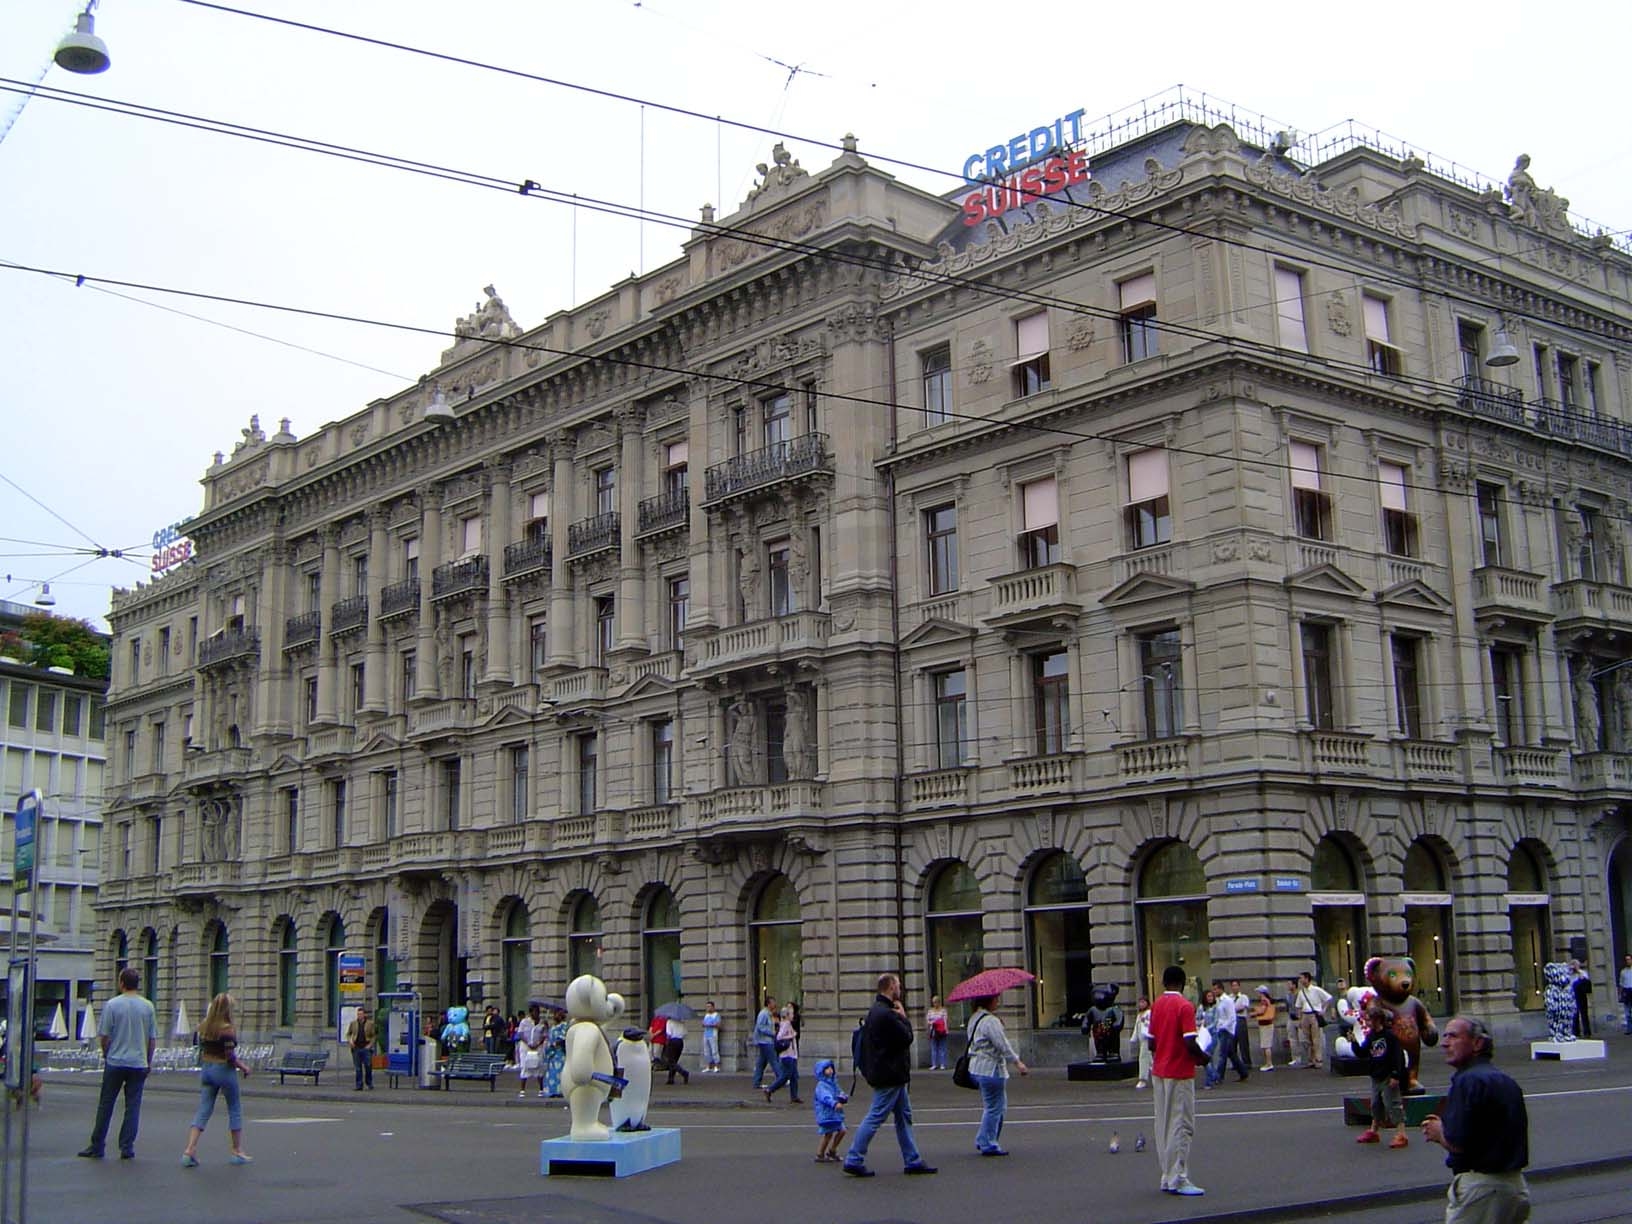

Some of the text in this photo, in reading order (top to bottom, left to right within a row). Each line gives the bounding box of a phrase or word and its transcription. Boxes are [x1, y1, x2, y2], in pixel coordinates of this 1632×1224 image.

[963, 108, 1087, 186] CREDIT
[963, 149, 1091, 228] SUISSE
[152, 515, 193, 549] CRE
[152, 540, 193, 572] SUISSE
